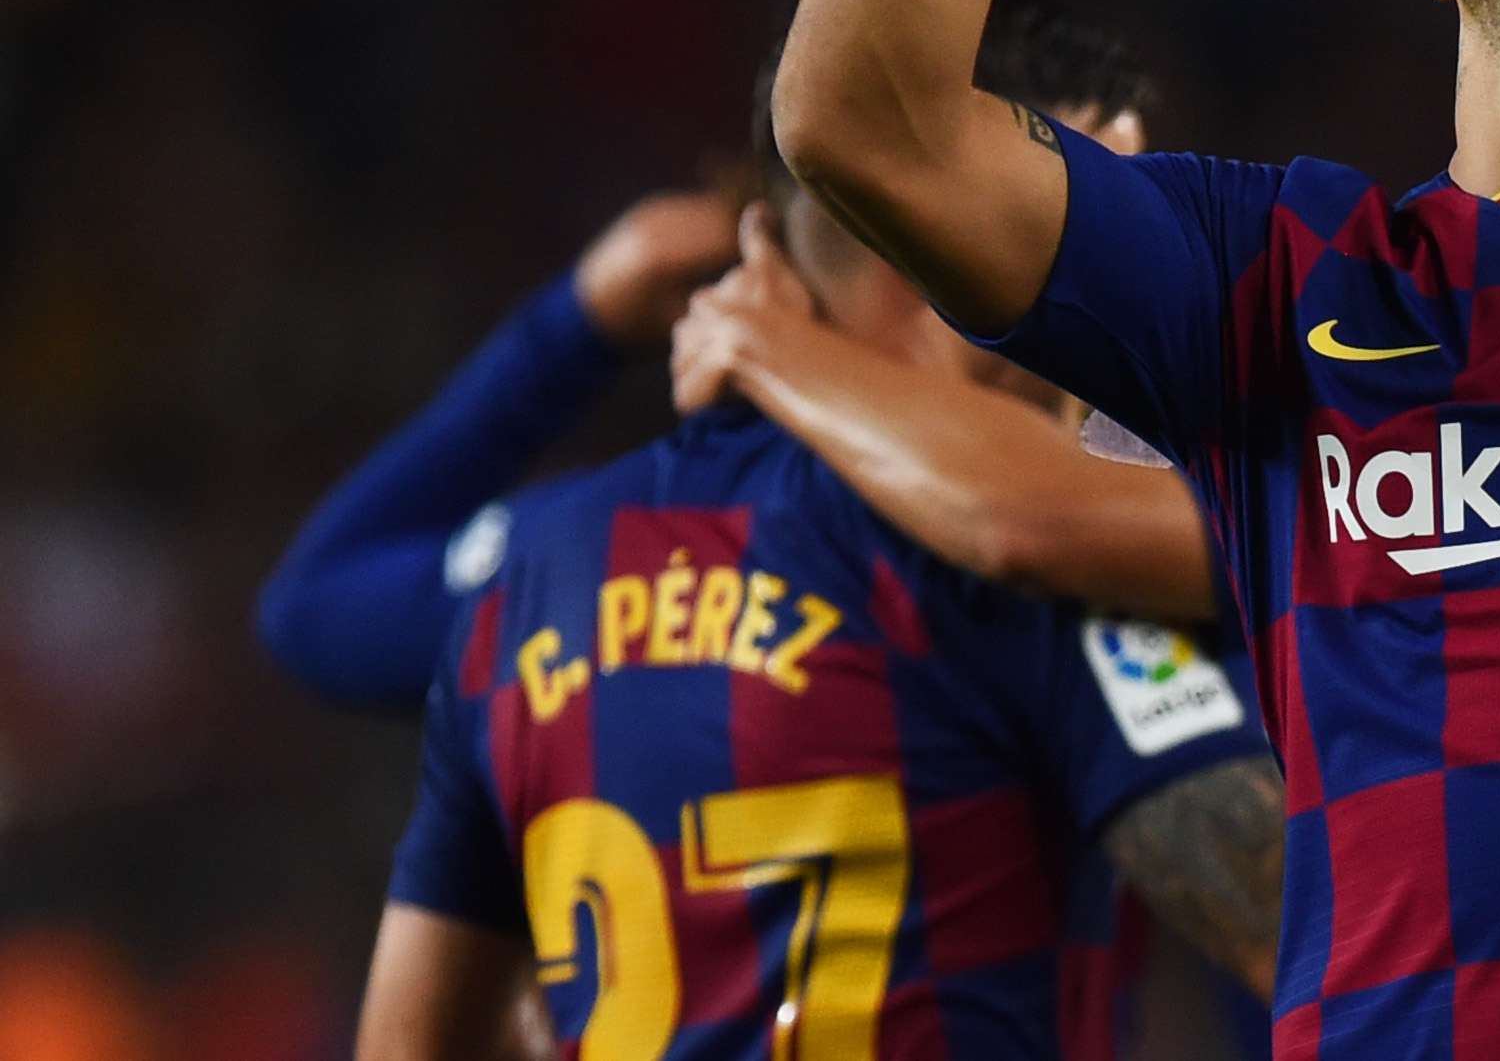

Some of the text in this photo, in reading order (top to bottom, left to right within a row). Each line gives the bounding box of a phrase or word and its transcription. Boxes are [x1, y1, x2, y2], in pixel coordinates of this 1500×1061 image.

[517, 548, 843, 724] C. PÉREZ
[523, 775, 910, 1061] 27
